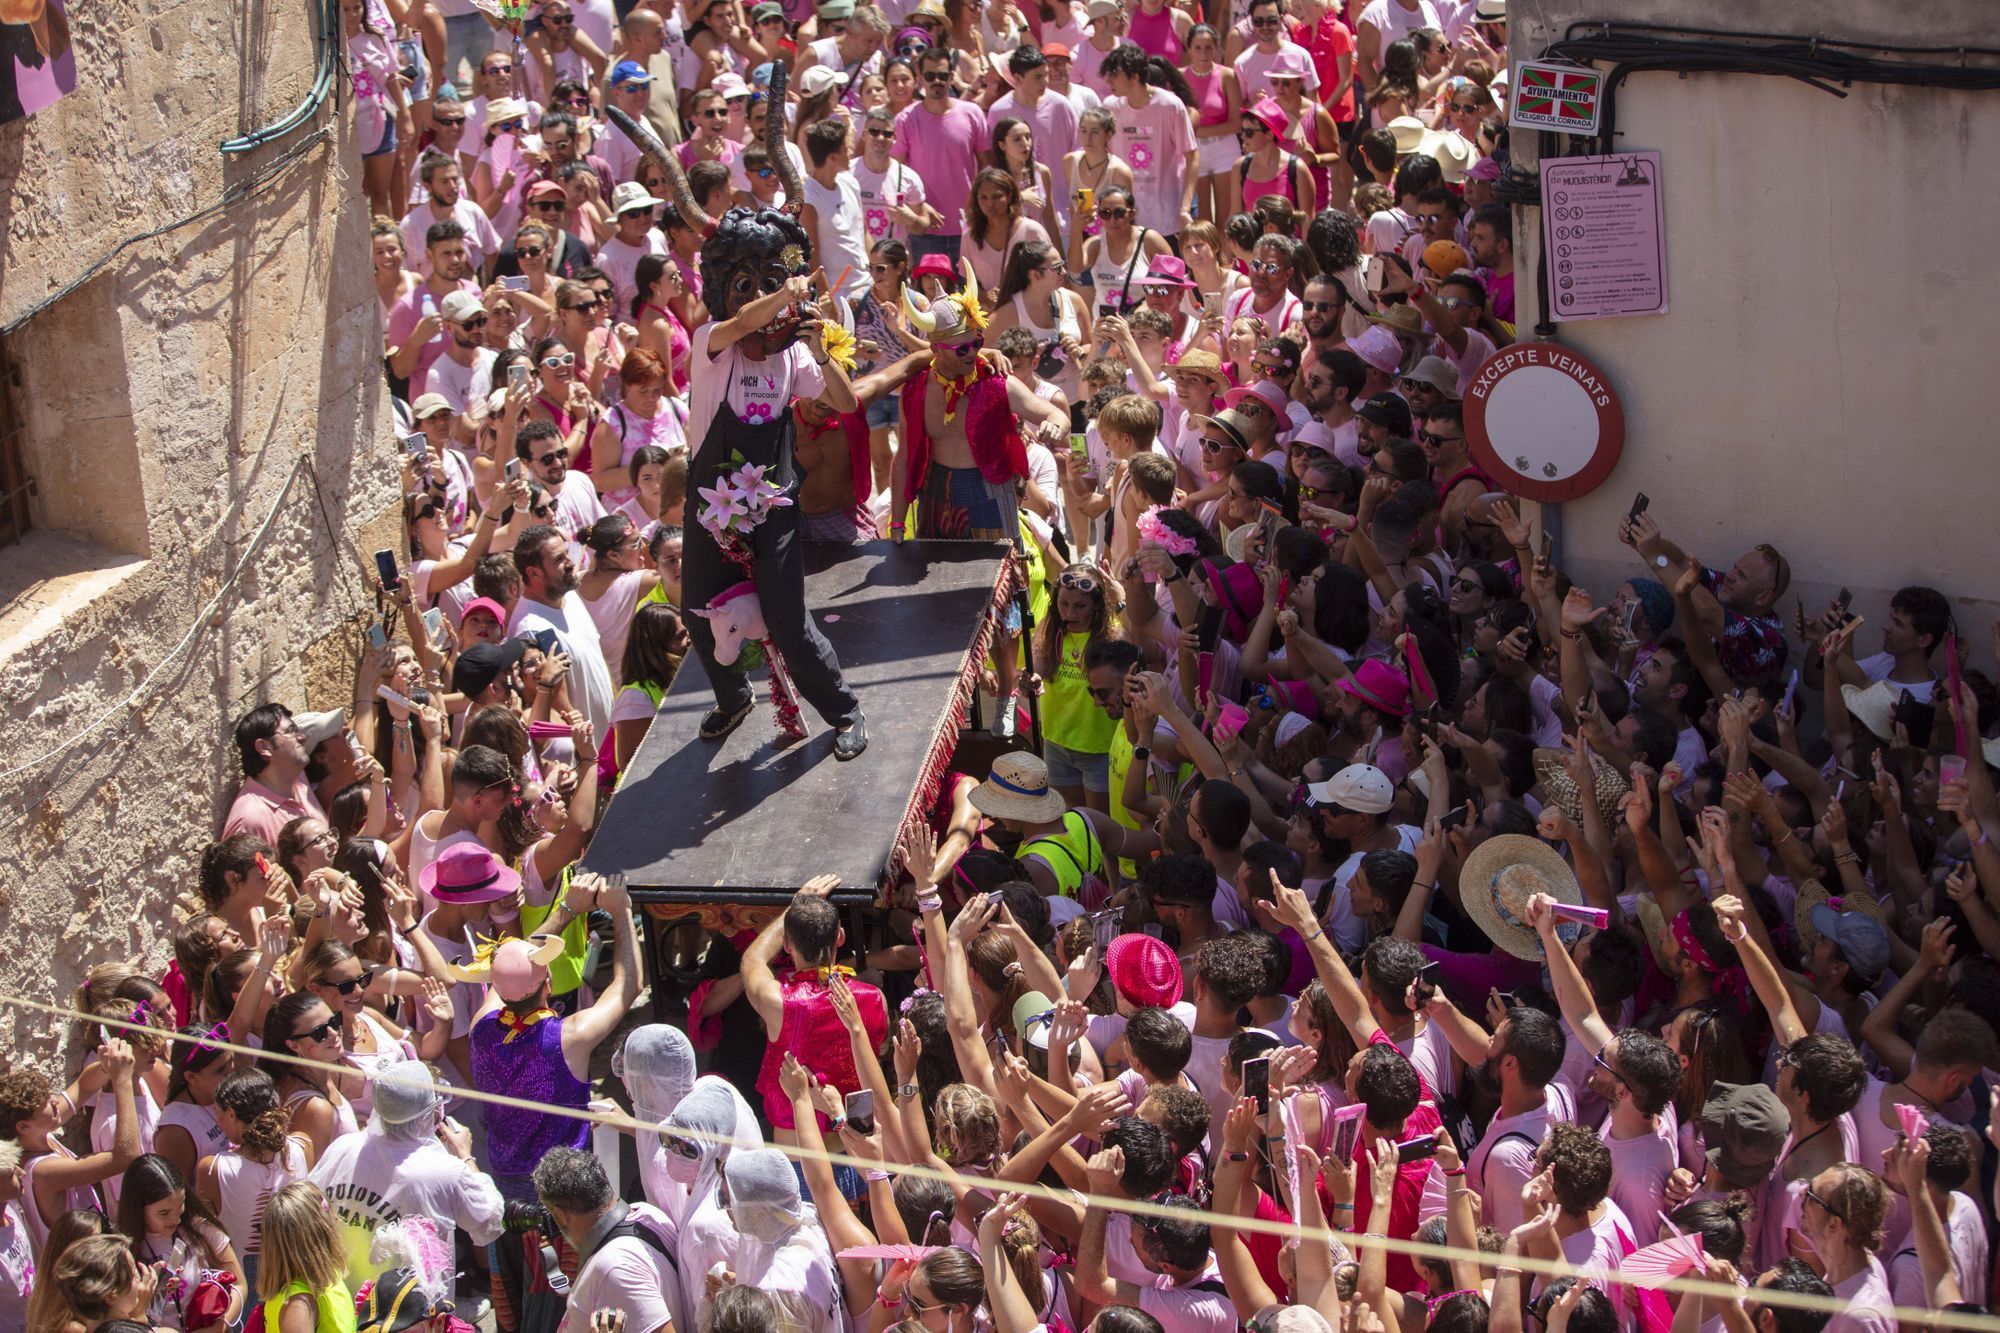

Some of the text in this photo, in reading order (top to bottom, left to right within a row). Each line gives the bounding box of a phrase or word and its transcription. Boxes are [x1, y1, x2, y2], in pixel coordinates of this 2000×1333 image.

[1526, 86, 1589, 103] AYUNTAMIENTO
[1517, 111, 1546, 122] PELIGRO
[1557, 117, 1592, 127] CORNADA
[1472, 350, 1610, 407] EXCEPTE VEINATS
[750, 391, 779, 399] mucada
